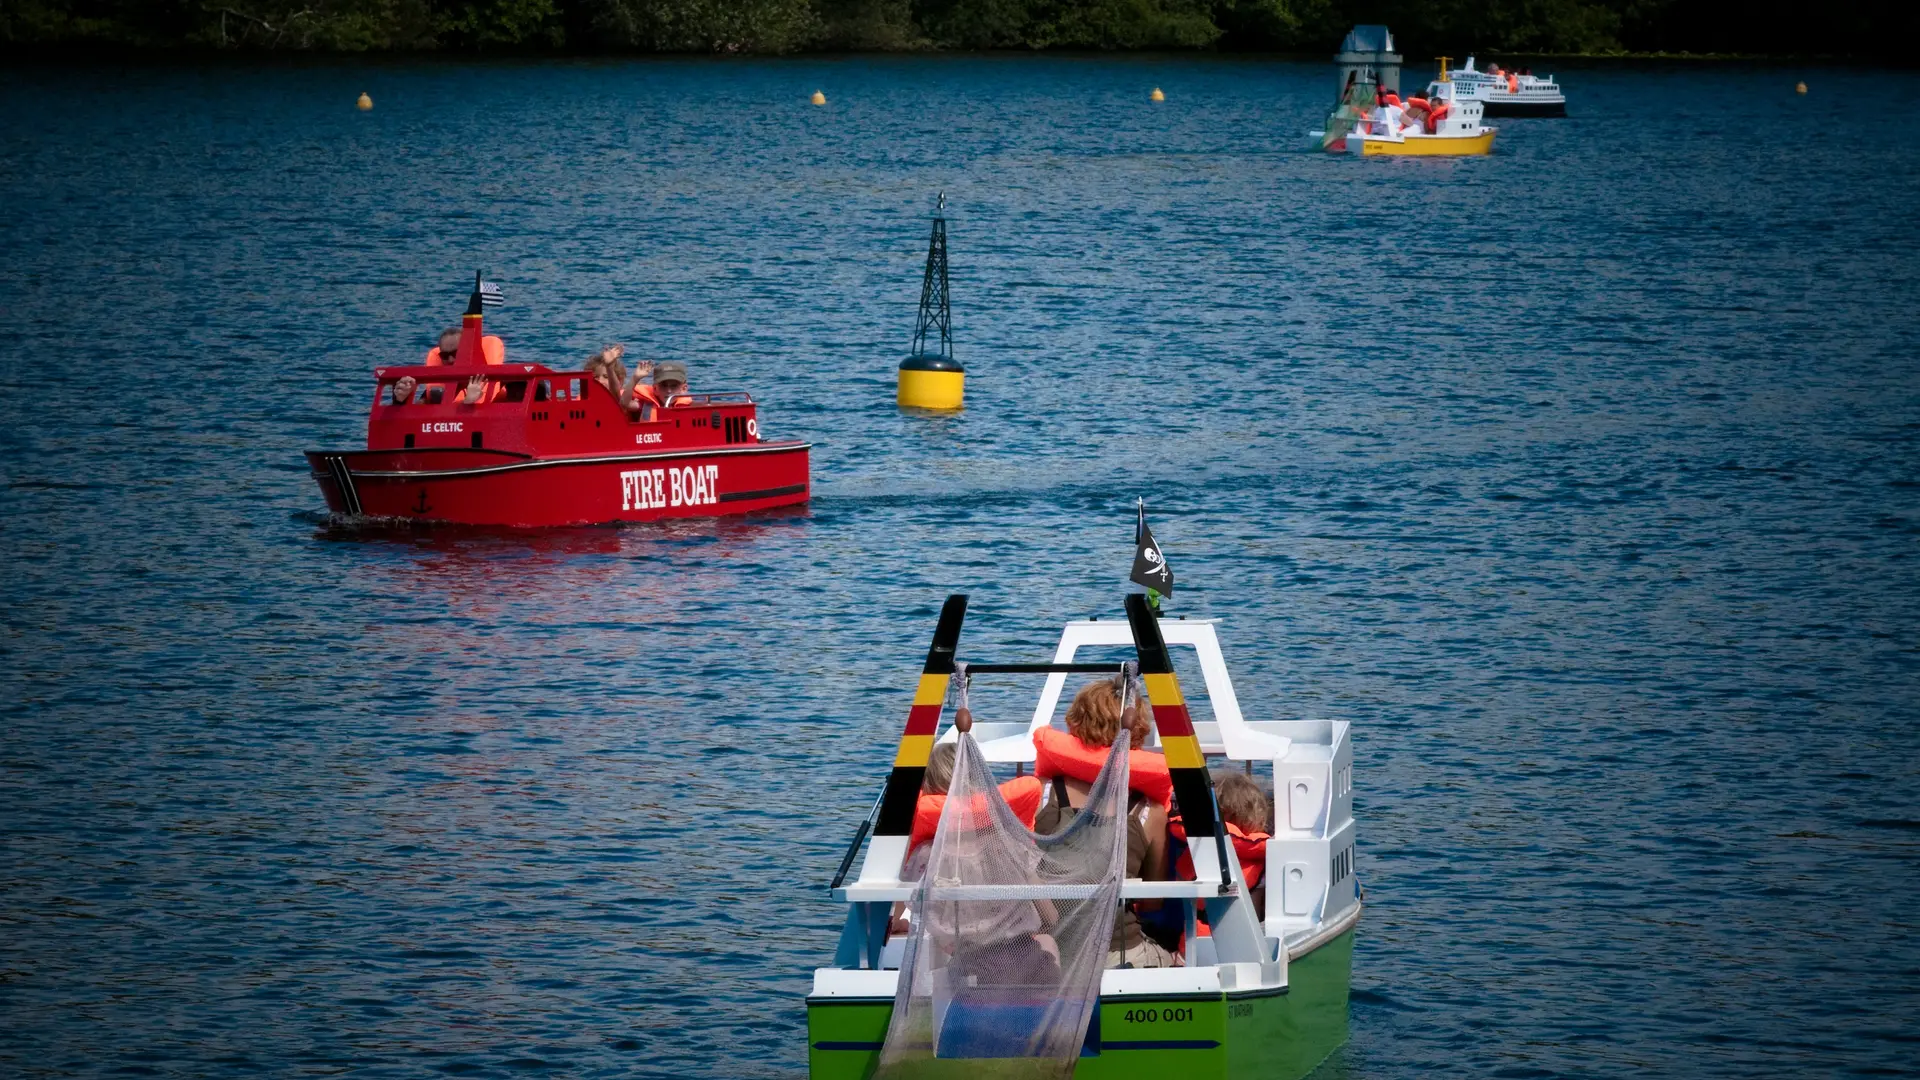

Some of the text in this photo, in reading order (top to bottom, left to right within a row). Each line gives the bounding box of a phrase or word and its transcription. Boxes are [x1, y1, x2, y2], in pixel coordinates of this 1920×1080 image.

[422, 422, 464, 433] LE CELTIC
[635, 432, 663, 444] LE CELTIC
[620, 465, 719, 511] FIRE BOAT
[1125, 1008, 1193, 1023] 400 001
